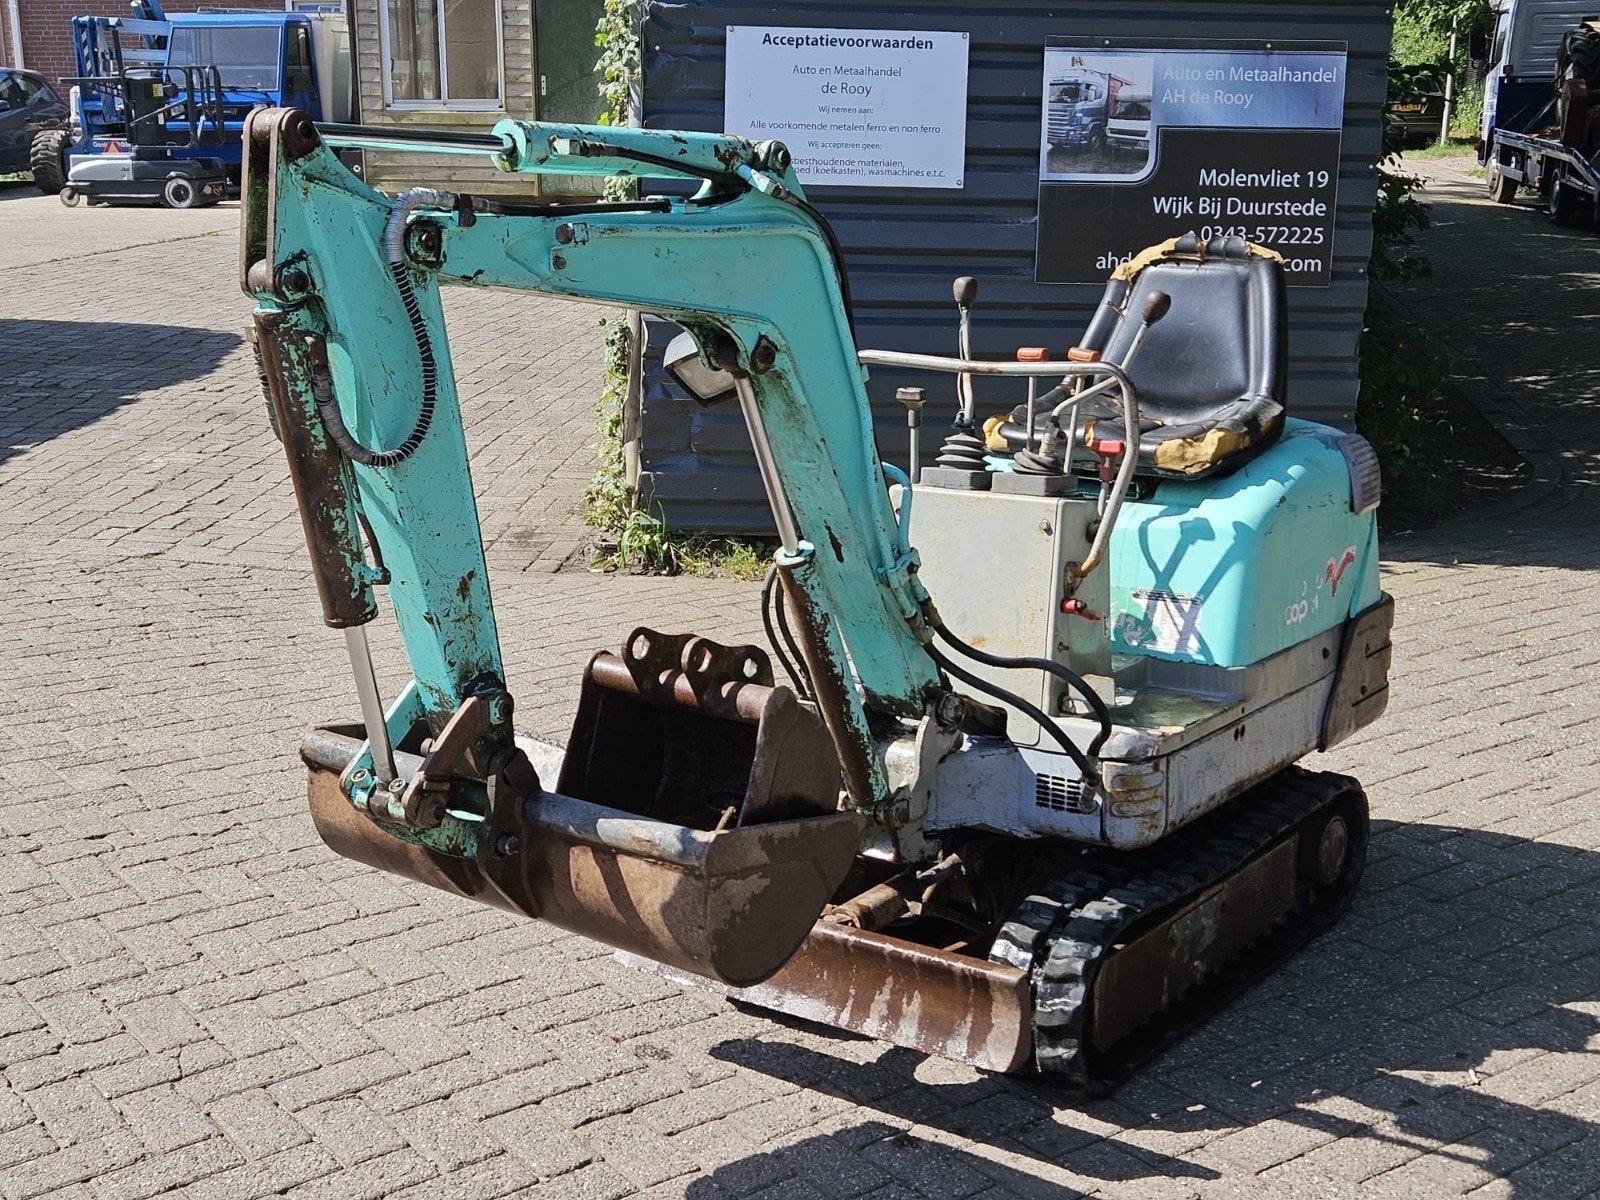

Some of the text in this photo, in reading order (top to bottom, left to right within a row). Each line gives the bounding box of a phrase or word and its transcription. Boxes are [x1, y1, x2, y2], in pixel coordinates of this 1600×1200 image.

[762, 33, 934, 50] Acceptatievoorwaarden
[792, 65, 902, 76] Auto en Metaalhandel
[1163, 66, 1337, 83] Auto en Metaalhandel
[821, 81, 872, 97] de Rooy
[1162, 89, 1253, 108] AH de Rooy
[818, 105, 830, 114] Wij
[750, 120, 766, 129] Alle
[768, 121, 828, 130] voorkomende
[830, 123, 865, 131] metalen
[866, 123, 887, 132] ferro
[920, 124, 941, 133] ferro
[808, 140, 819, 149] Wij
[861, 143, 883, 151] geen:
[790, 157, 905, 168] sbesthoudende materialen,
[812, 166, 866, 176] (koelkasten),
[868, 167, 925, 177] wasmachines
[1199, 168, 1330, 188] Molenvliet 19
[1152, 196, 1327, 220] Wijk Bij Duurstede
[1200, 225, 1324, 244] 0343-572225
